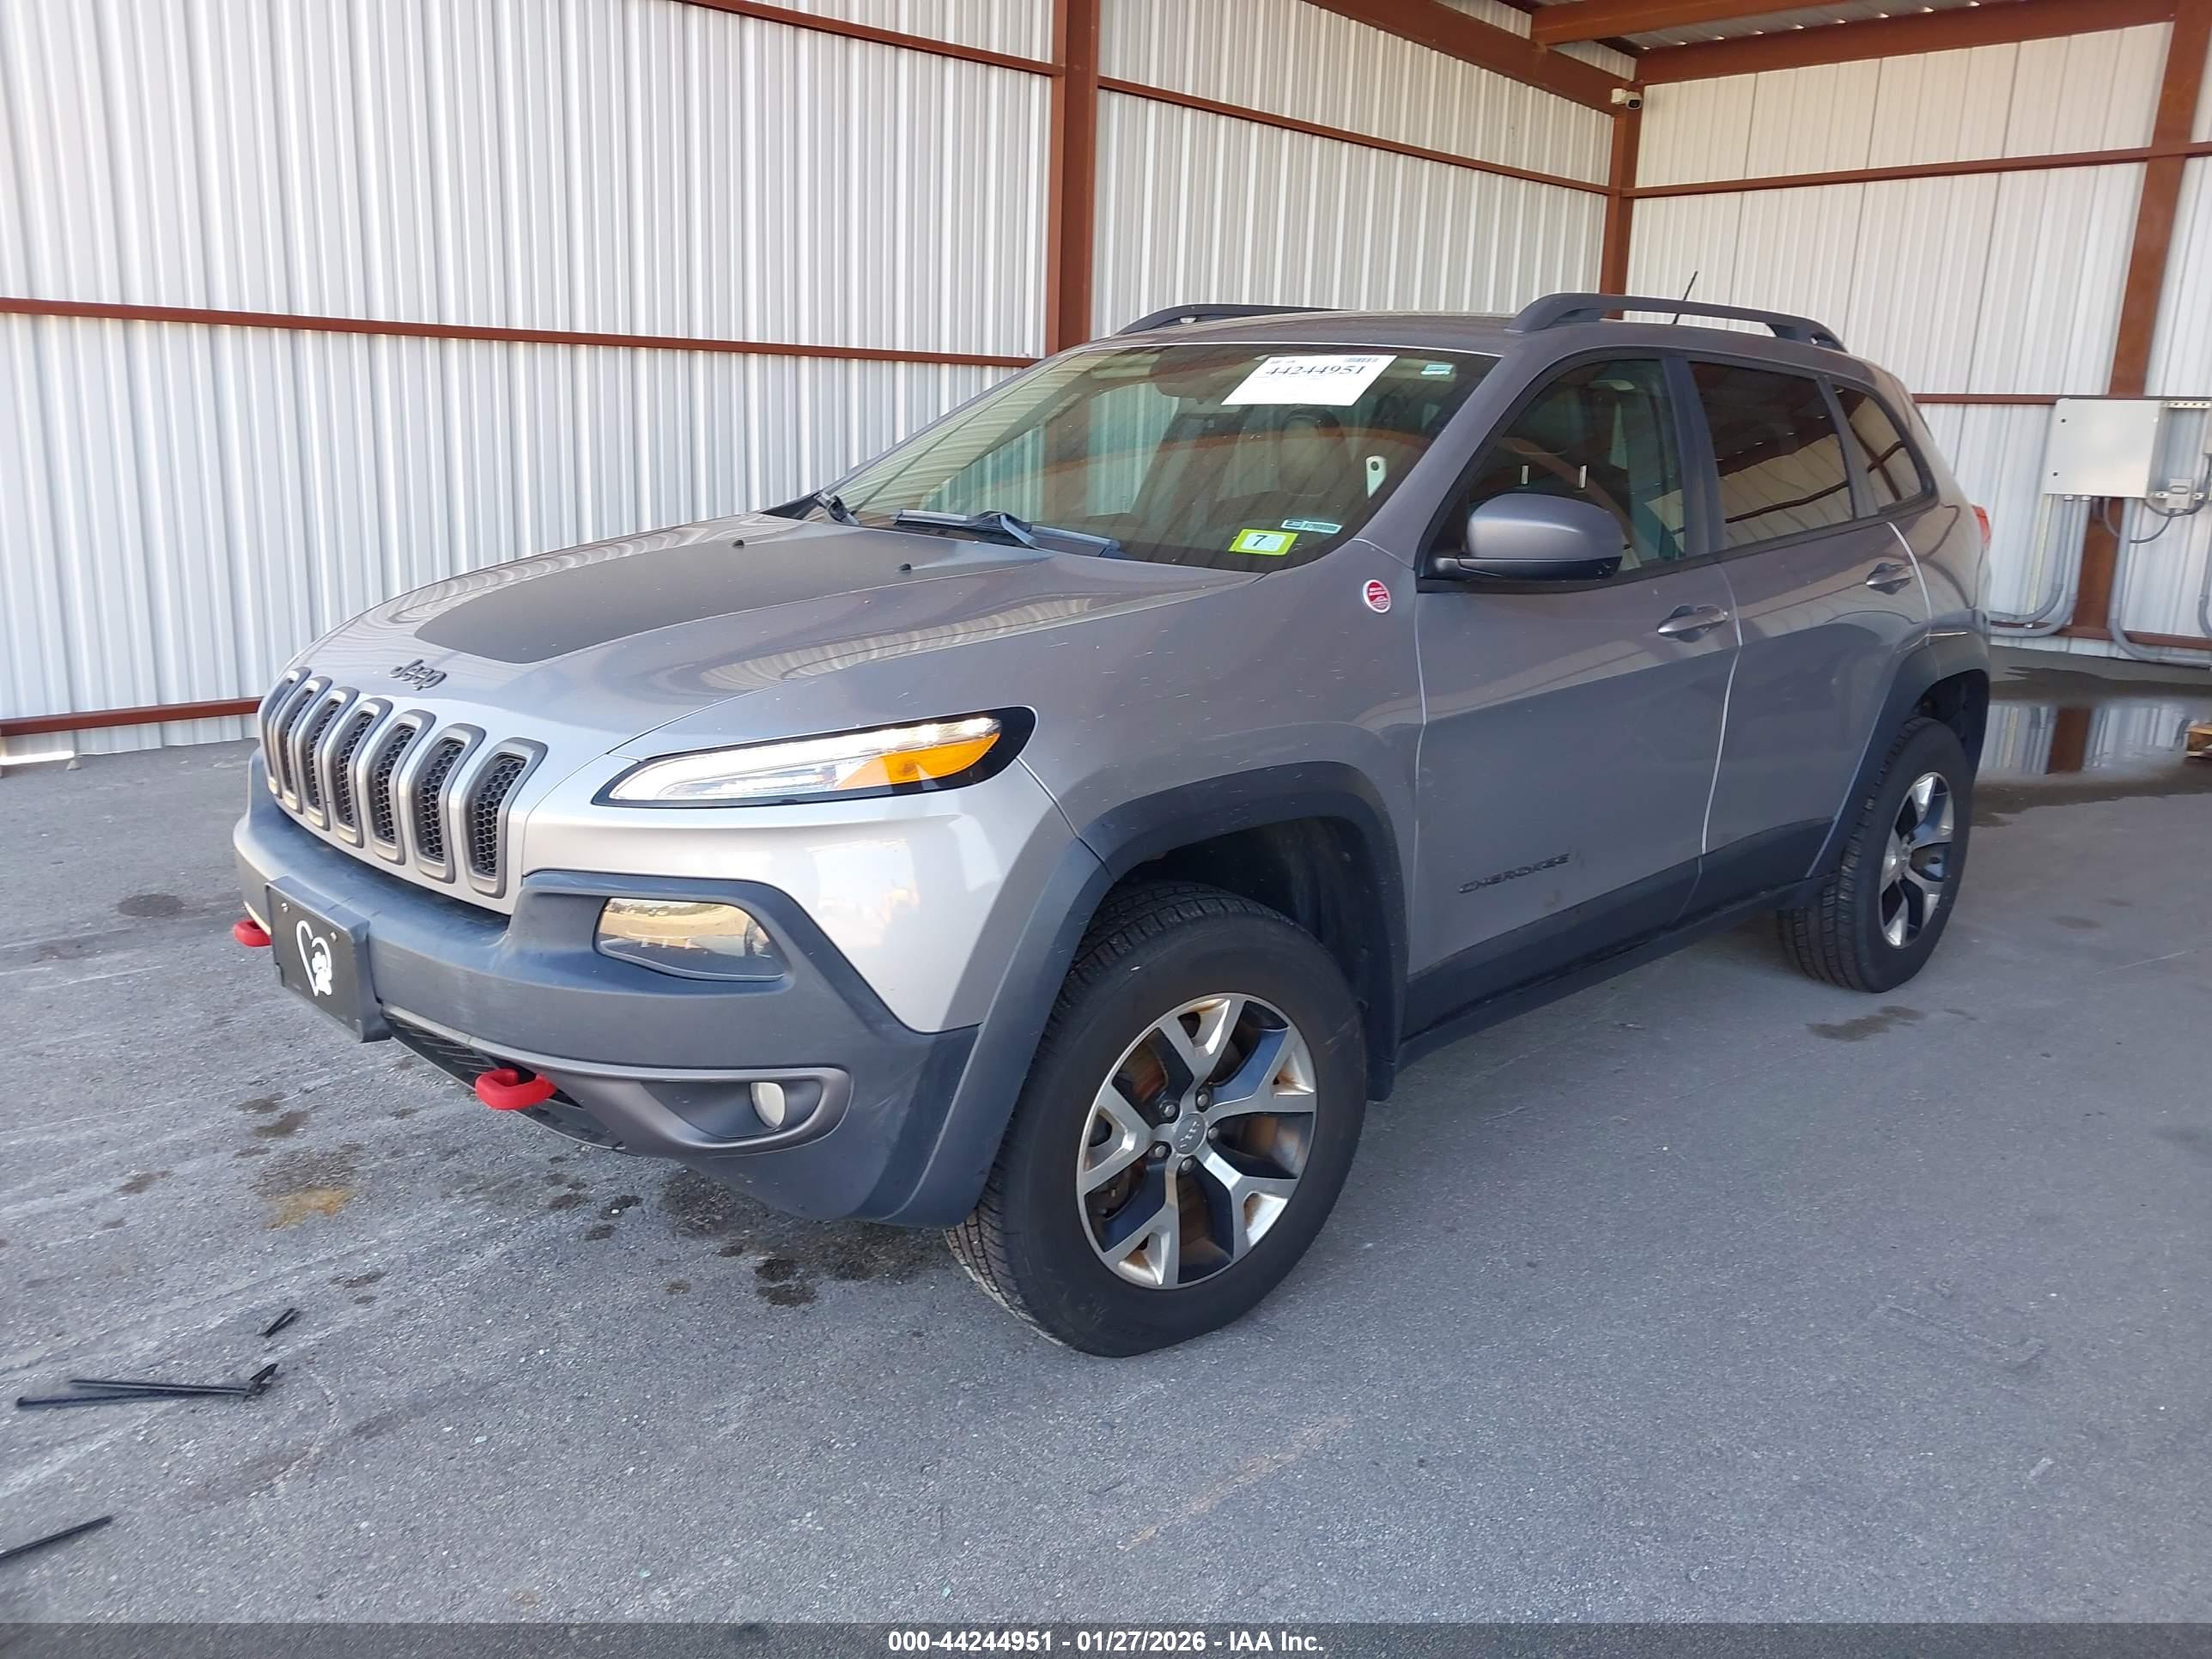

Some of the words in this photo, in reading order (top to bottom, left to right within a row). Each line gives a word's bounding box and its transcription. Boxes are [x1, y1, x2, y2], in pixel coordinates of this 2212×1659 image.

[1266, 365, 1366, 375] 44244951
[1251, 534, 1267, 547] 7
[388, 659, 447, 691] Jeep
[1458, 853, 1571, 894] CHEROKEE
